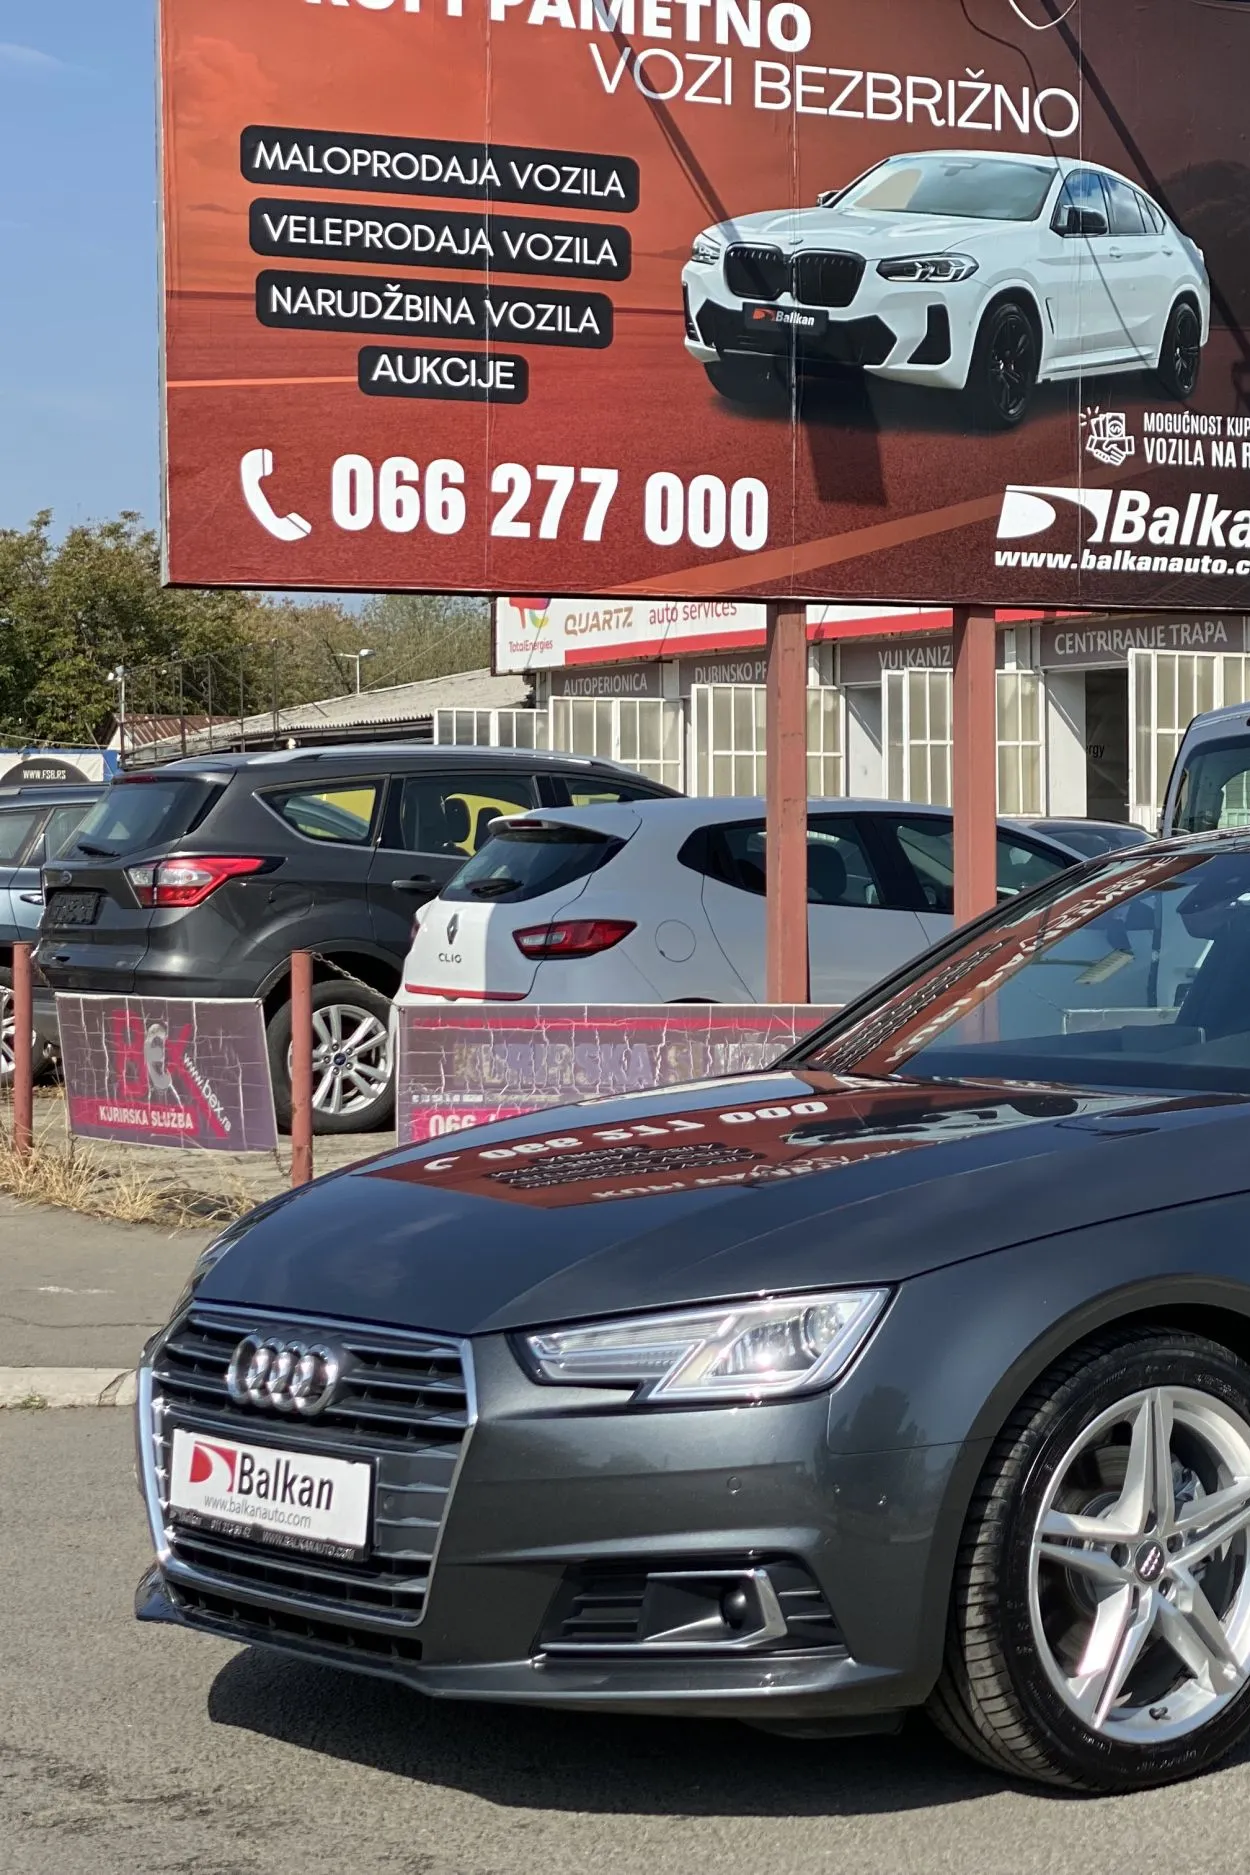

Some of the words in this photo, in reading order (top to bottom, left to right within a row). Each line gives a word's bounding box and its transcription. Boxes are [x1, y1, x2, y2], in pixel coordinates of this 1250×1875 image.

[589, 43, 732, 106] VOZI
[754, 60, 1081, 138] BEZBRIŽNO
[253, 141, 501, 187] MALOPRODAJA
[510, 161, 625, 199] VOZILA
[262, 213, 494, 257] VELEPRODAJA
[504, 231, 617, 267] VOZILA
[270, 282, 475, 326] NARUDŽBINA
[485, 300, 600, 336] VOZILA
[775, 309, 815, 326] Balkan
[371, 354, 515, 390] AUKCIJE
[1143, 410, 1222, 436] MOGUĆNOST
[1143, 438, 1204, 467] VOZILA
[1211, 441, 1238, 469] NA
[332, 453, 466, 535] 066
[490, 462, 619, 541] 277
[644, 471, 769, 551] 000
[564, 606, 634, 637] QUARTZ
[649, 604, 678, 625] auto
[682, 602, 737, 622] services
[508, 638, 553, 655] TotalEnergies
[1055, 624, 1165, 656] CENTRIRANJE
[1169, 620, 1229, 647] TRAPA
[879, 645, 953, 670] VULKANIZ
[564, 673, 648, 696] AUTOPERIONICA
[695, 662, 751, 685] DUBINSKO
[23, 769, 67, 780] WWW.FSB.RS
[438, 952, 462, 964] CLIO
[99, 1105, 149, 1127] KURIRSKA
[151, 1108, 194, 1131] SLUŽBA
[237, 1452, 334, 1511] Balkan
[204, 1495, 312, 1529] www.balkanauto.com
